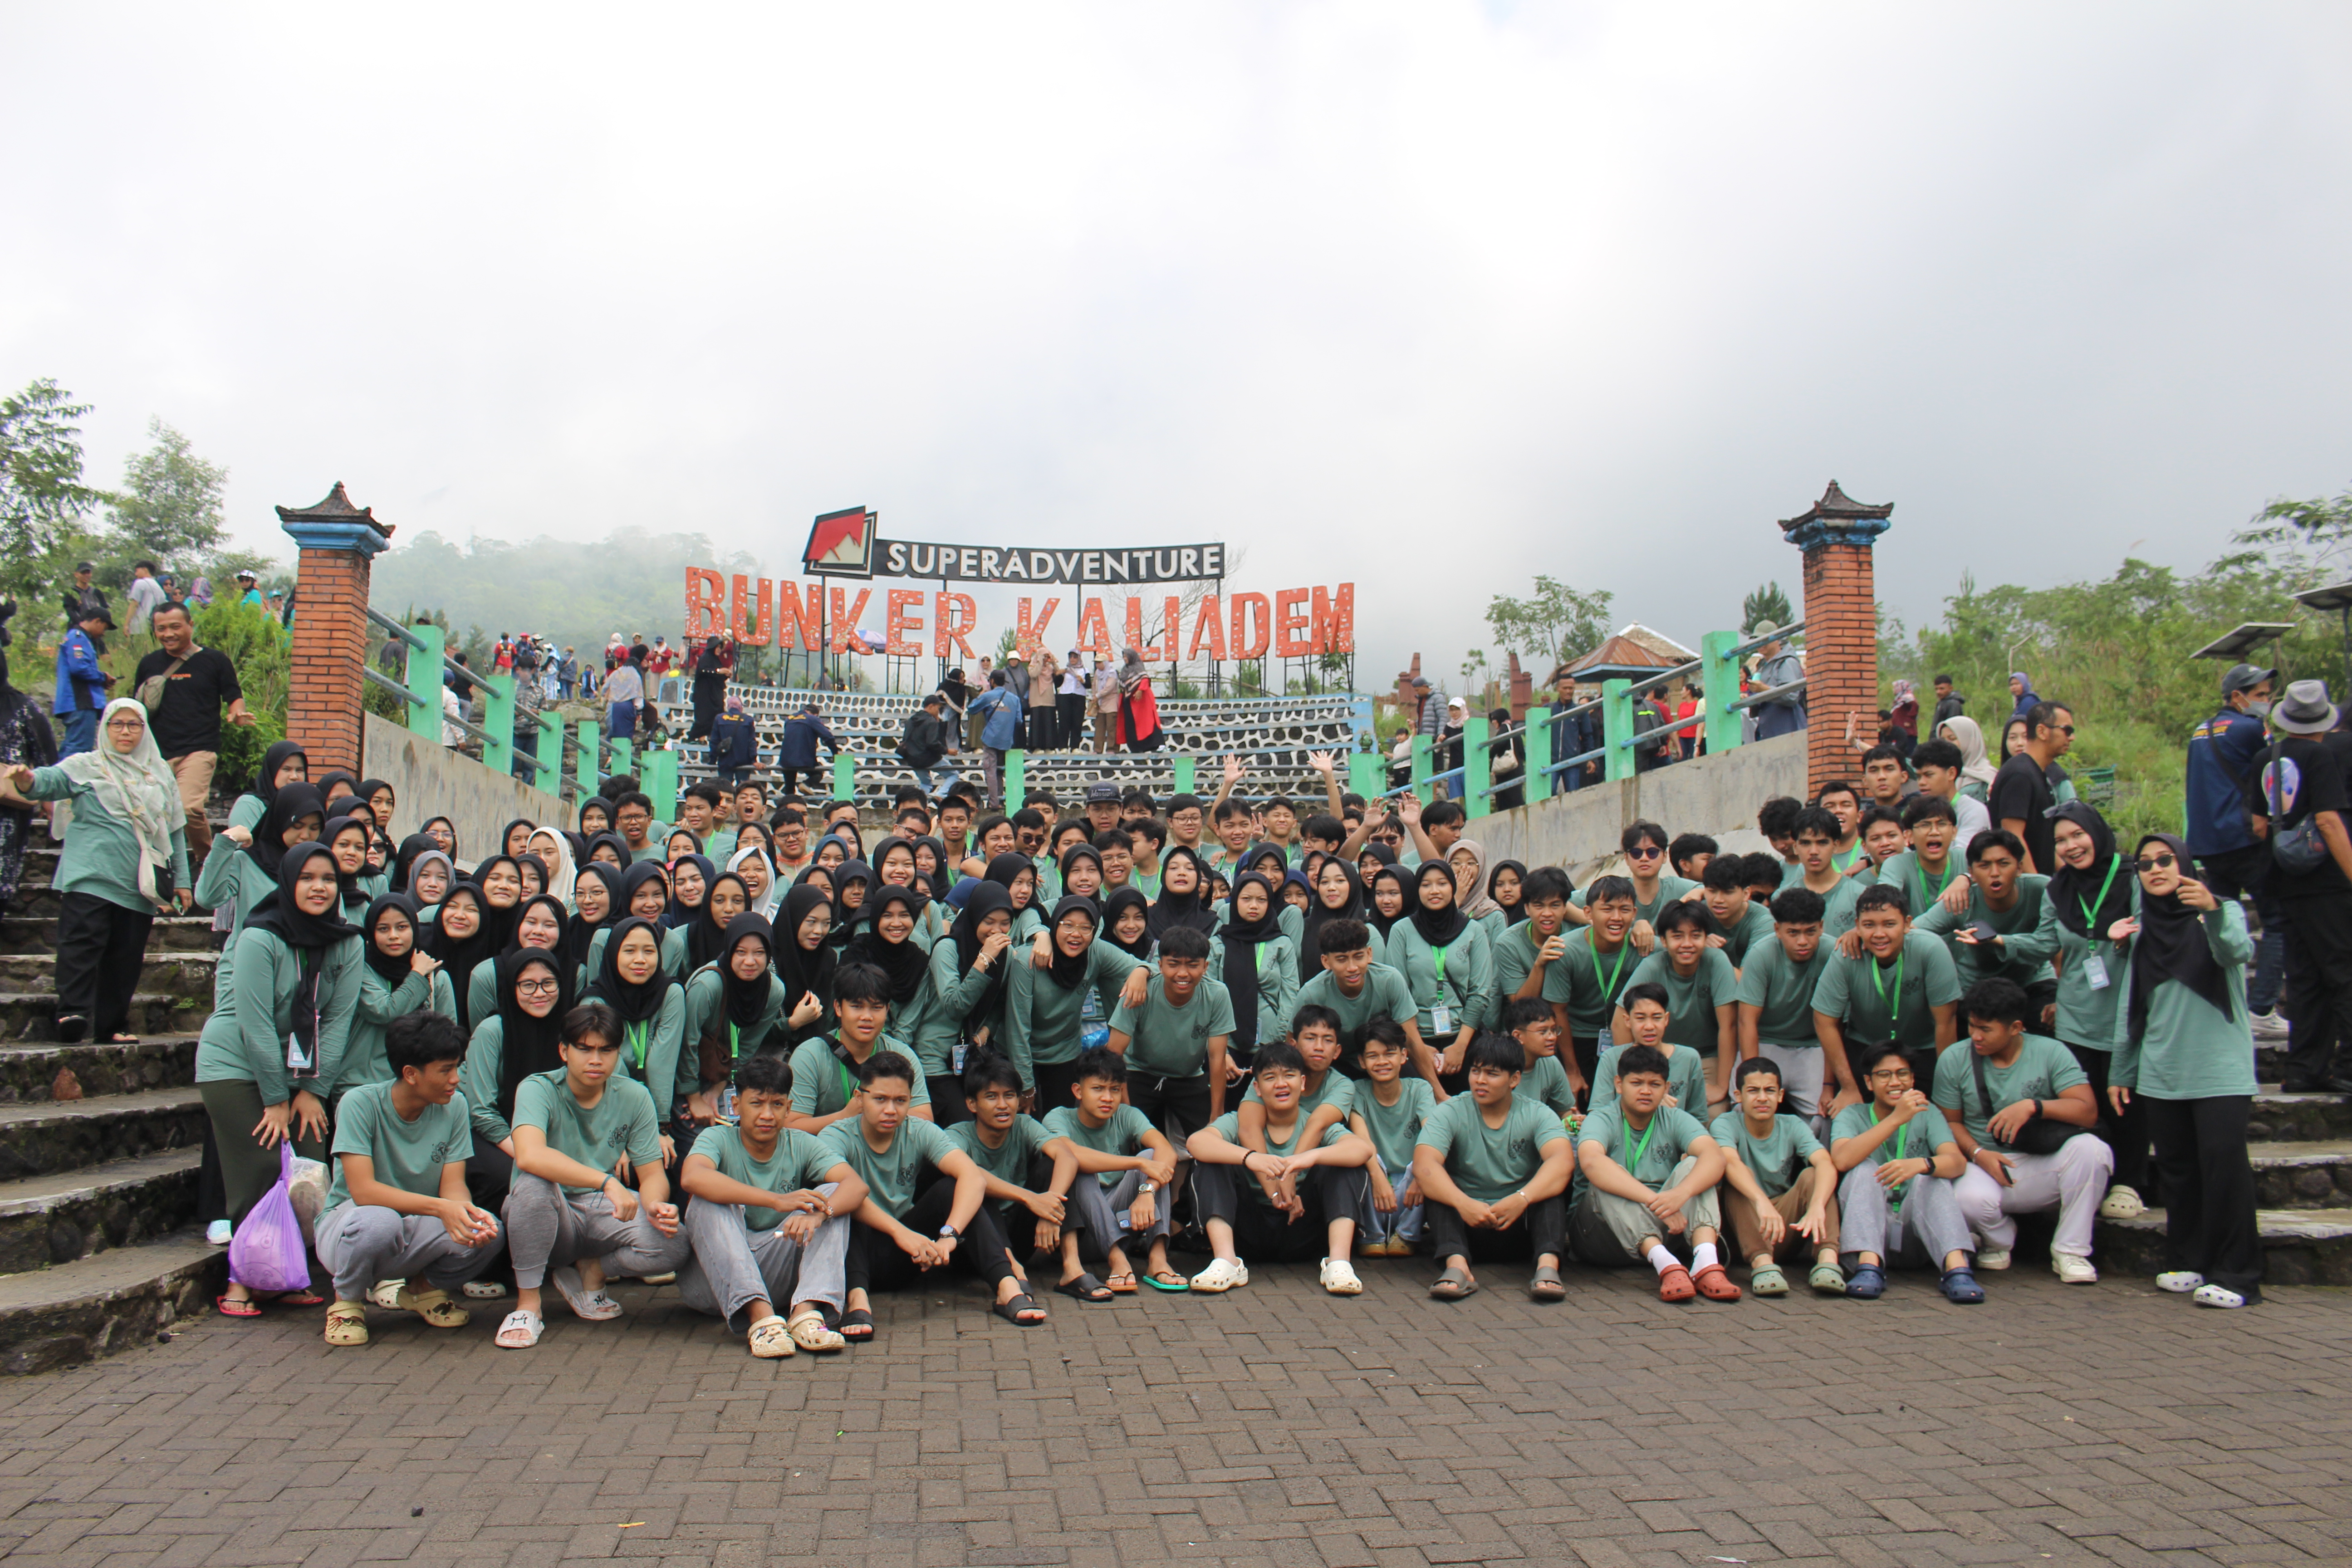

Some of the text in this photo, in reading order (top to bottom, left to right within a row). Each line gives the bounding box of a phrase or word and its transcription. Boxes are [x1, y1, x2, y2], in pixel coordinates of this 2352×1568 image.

[887, 543, 1220, 581] SUPERADVENTURE
[685, 566, 1354, 662] BUNKER KALIADEM
